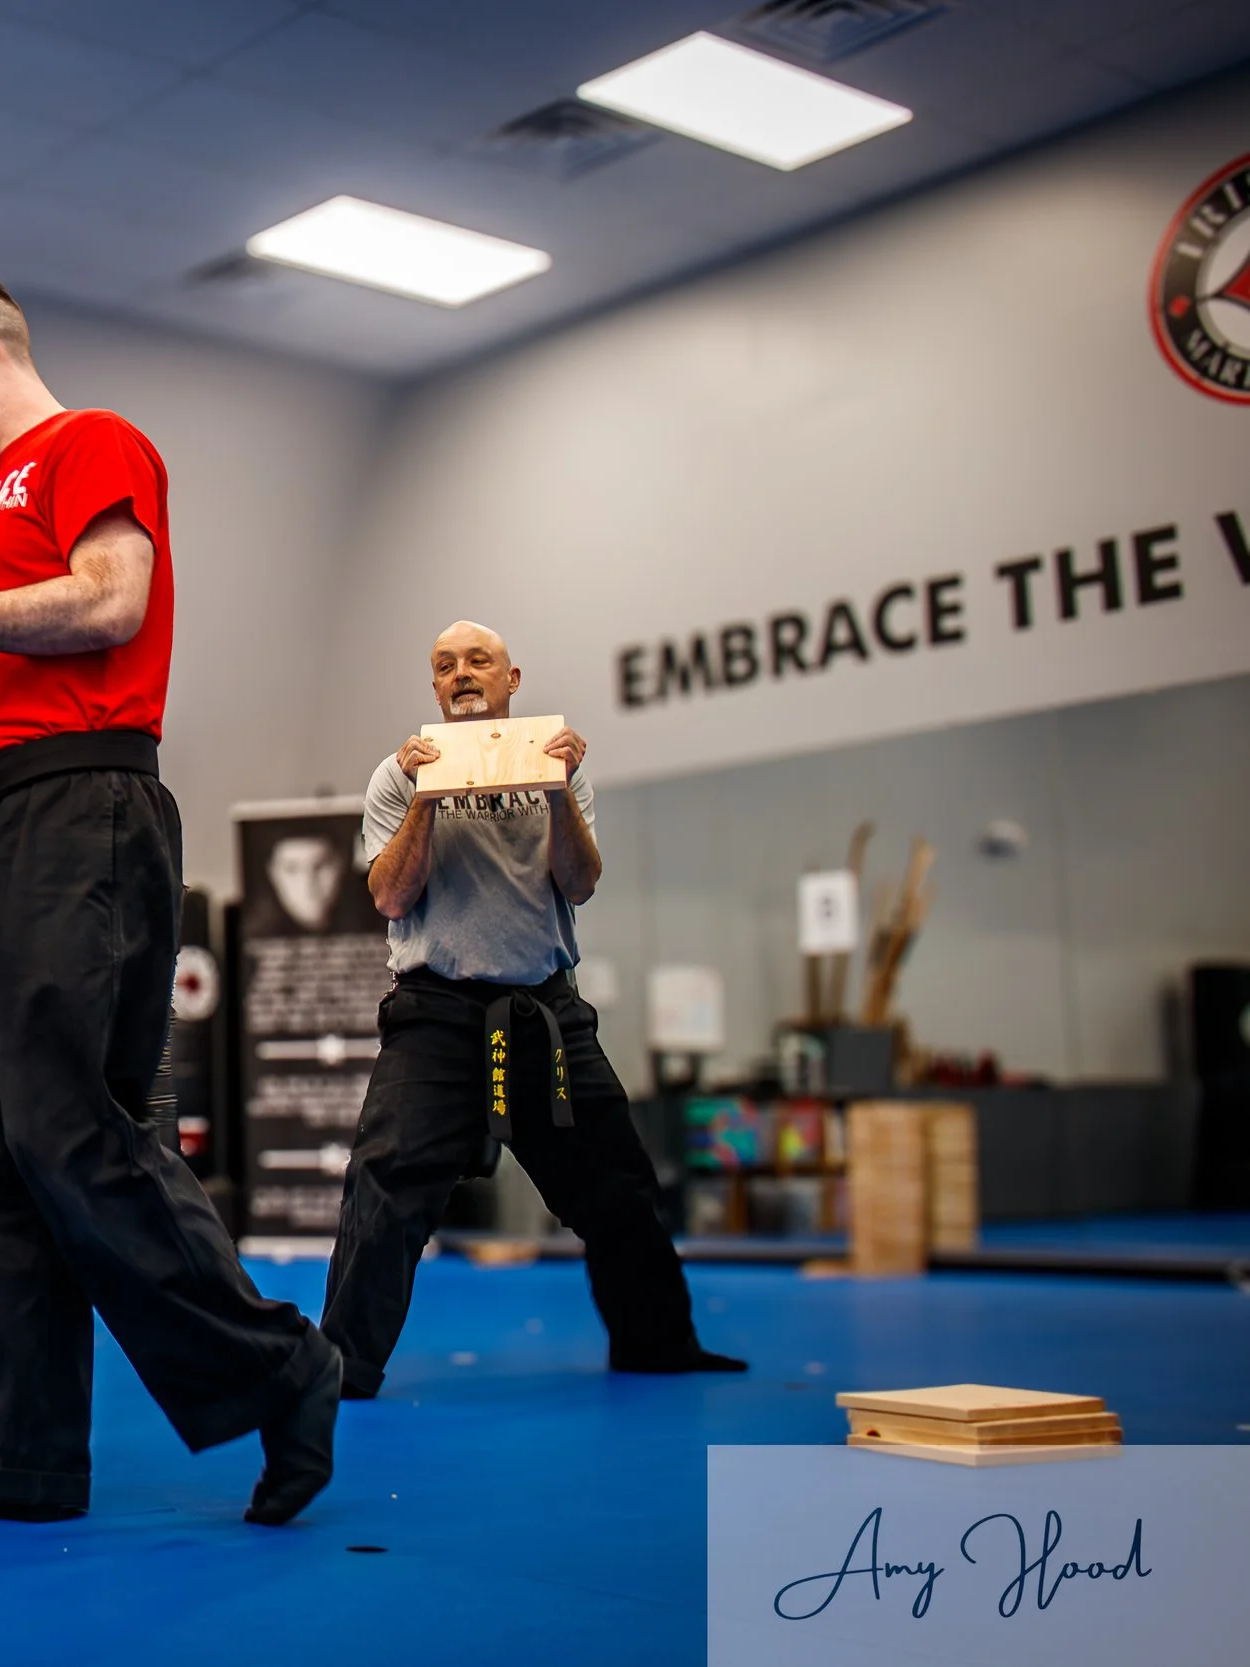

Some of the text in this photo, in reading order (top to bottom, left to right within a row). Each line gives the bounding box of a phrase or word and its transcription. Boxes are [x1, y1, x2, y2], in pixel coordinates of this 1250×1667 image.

[1187, 328, 1250, 389] MAR
[616, 573, 967, 711] EMBRACE
[994, 523, 1184, 632] THE
[437, 790, 551, 812] EMBRAC
[438, 810, 463, 820] THE
[465, 808, 515, 822] WARRIOR
[490, 1029, 507, 1116] 武神館道場
[555, 1048, 567, 1100] クリス
